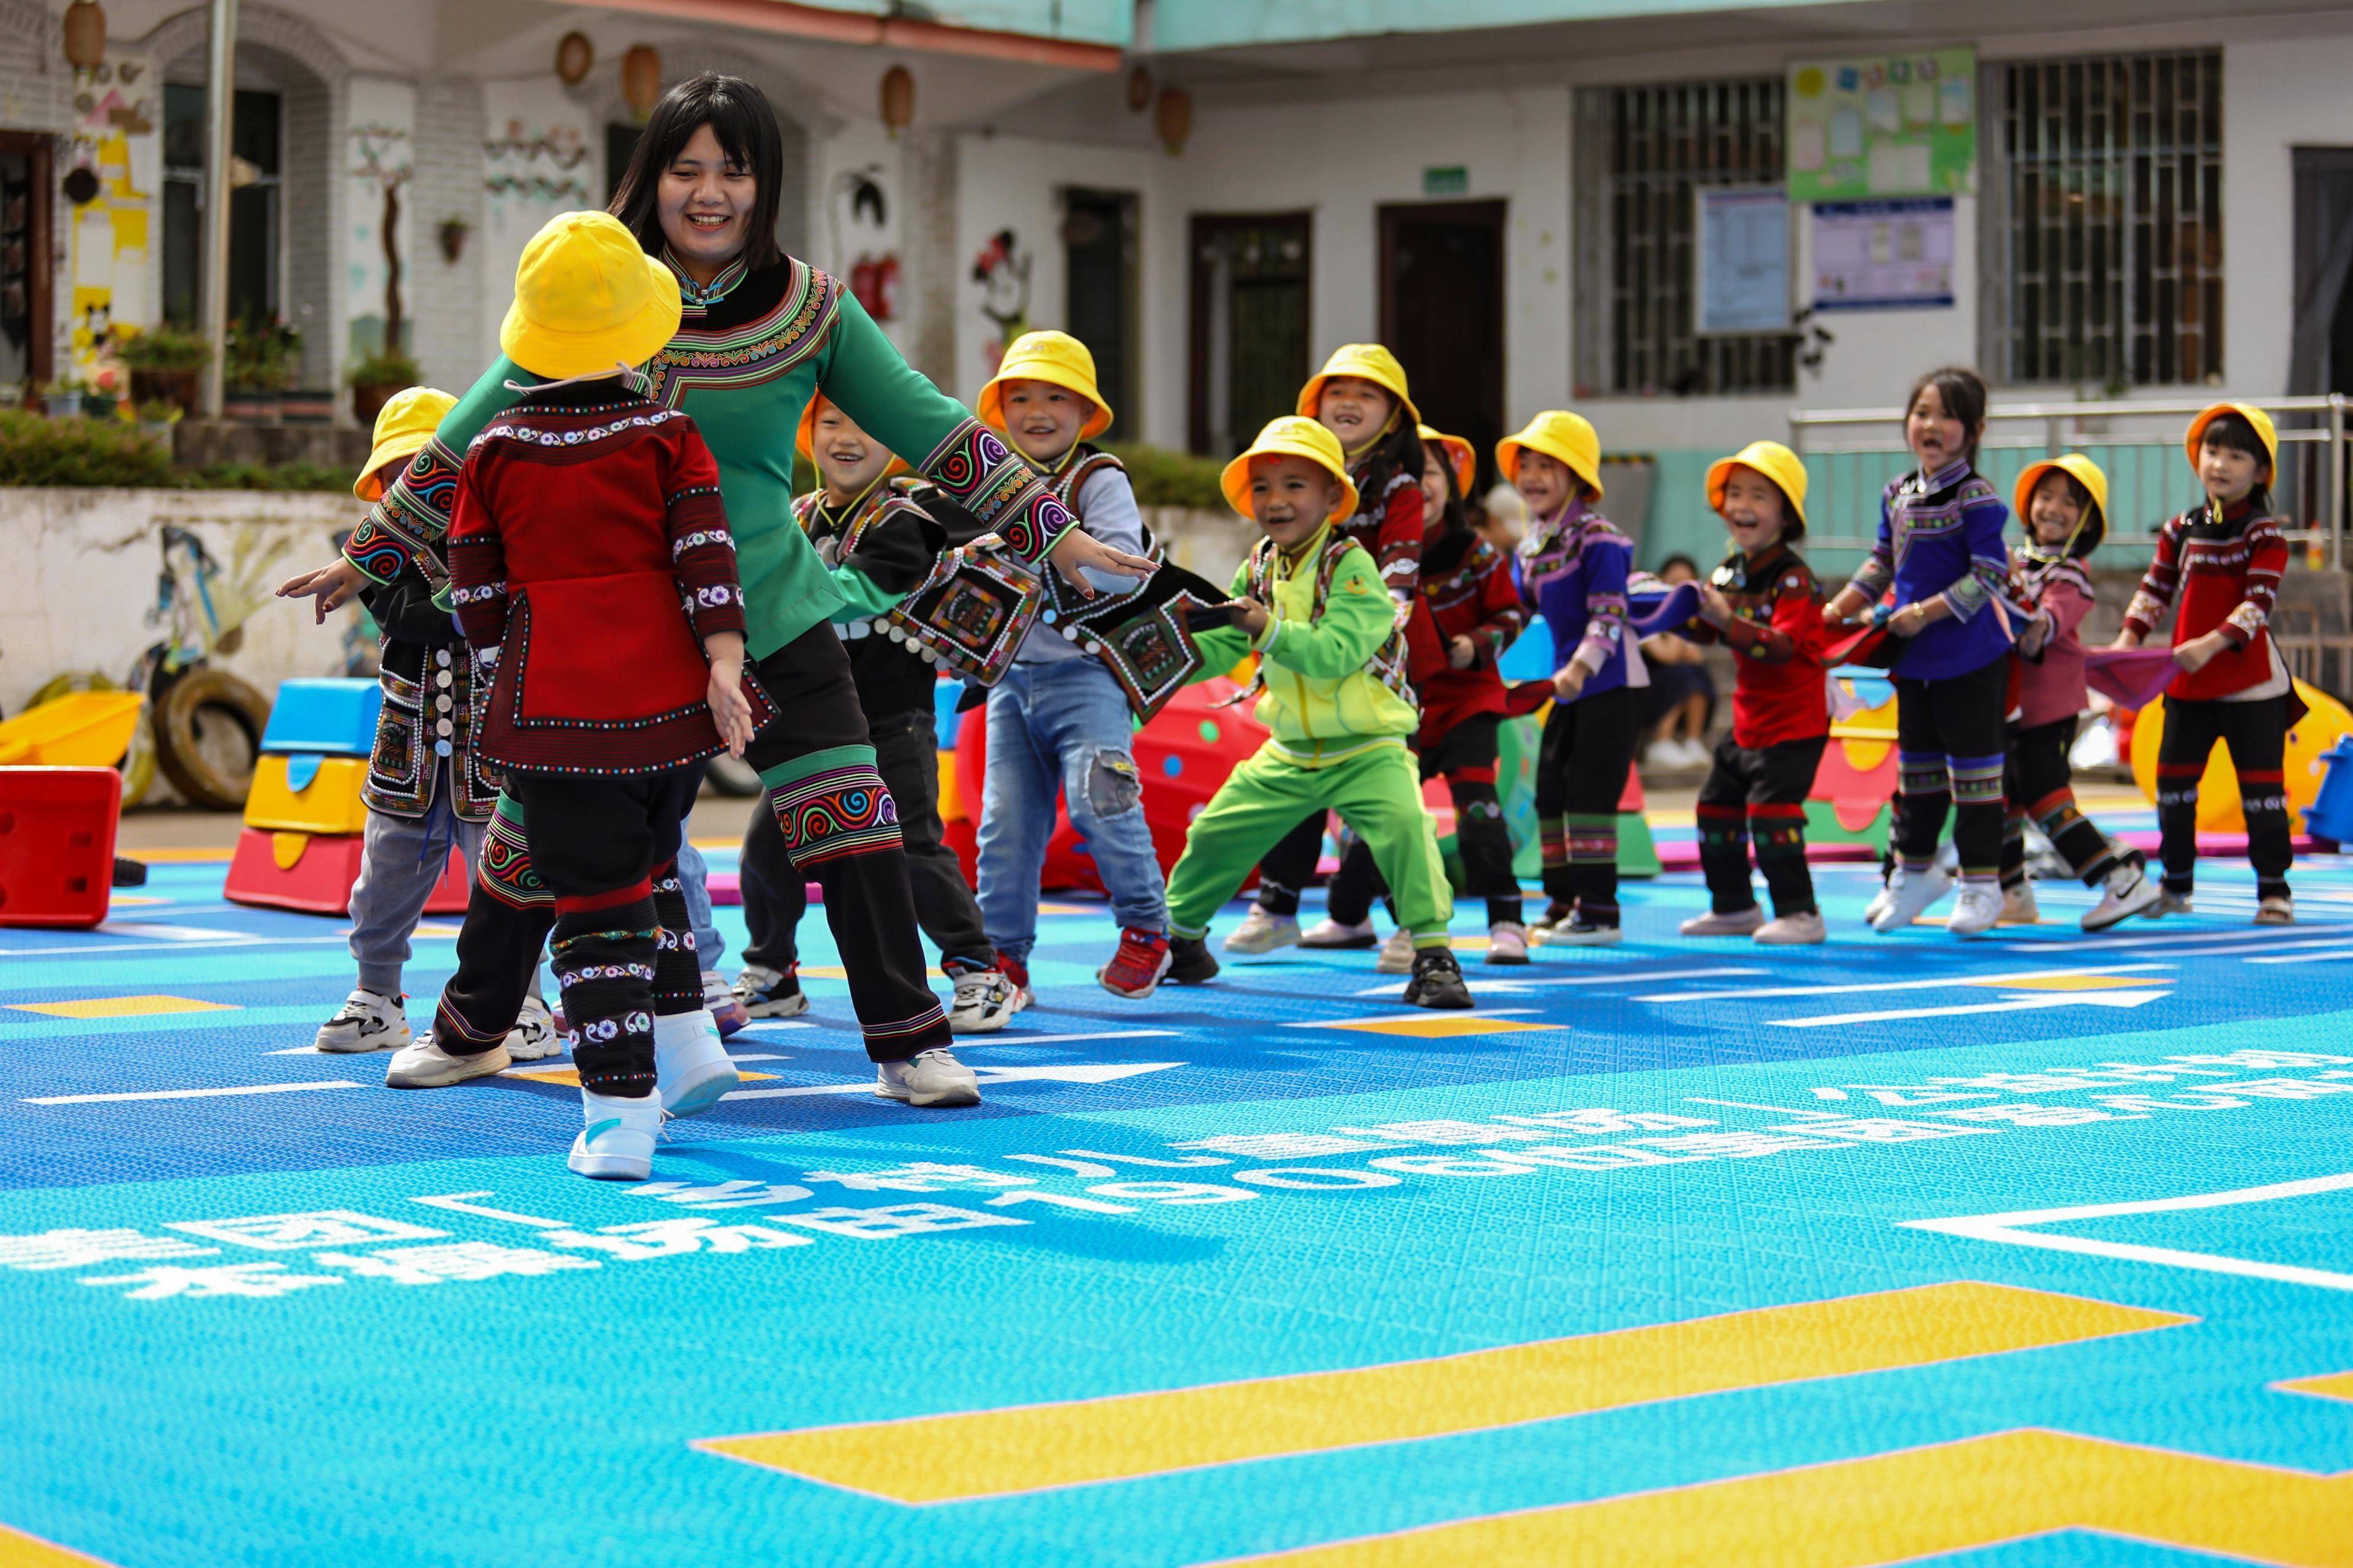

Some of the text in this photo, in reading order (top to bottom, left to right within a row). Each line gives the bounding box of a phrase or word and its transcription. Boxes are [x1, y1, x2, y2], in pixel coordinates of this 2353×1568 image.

[76, 1070, 2353, 1300] 本操场由1906位美团爱心网
